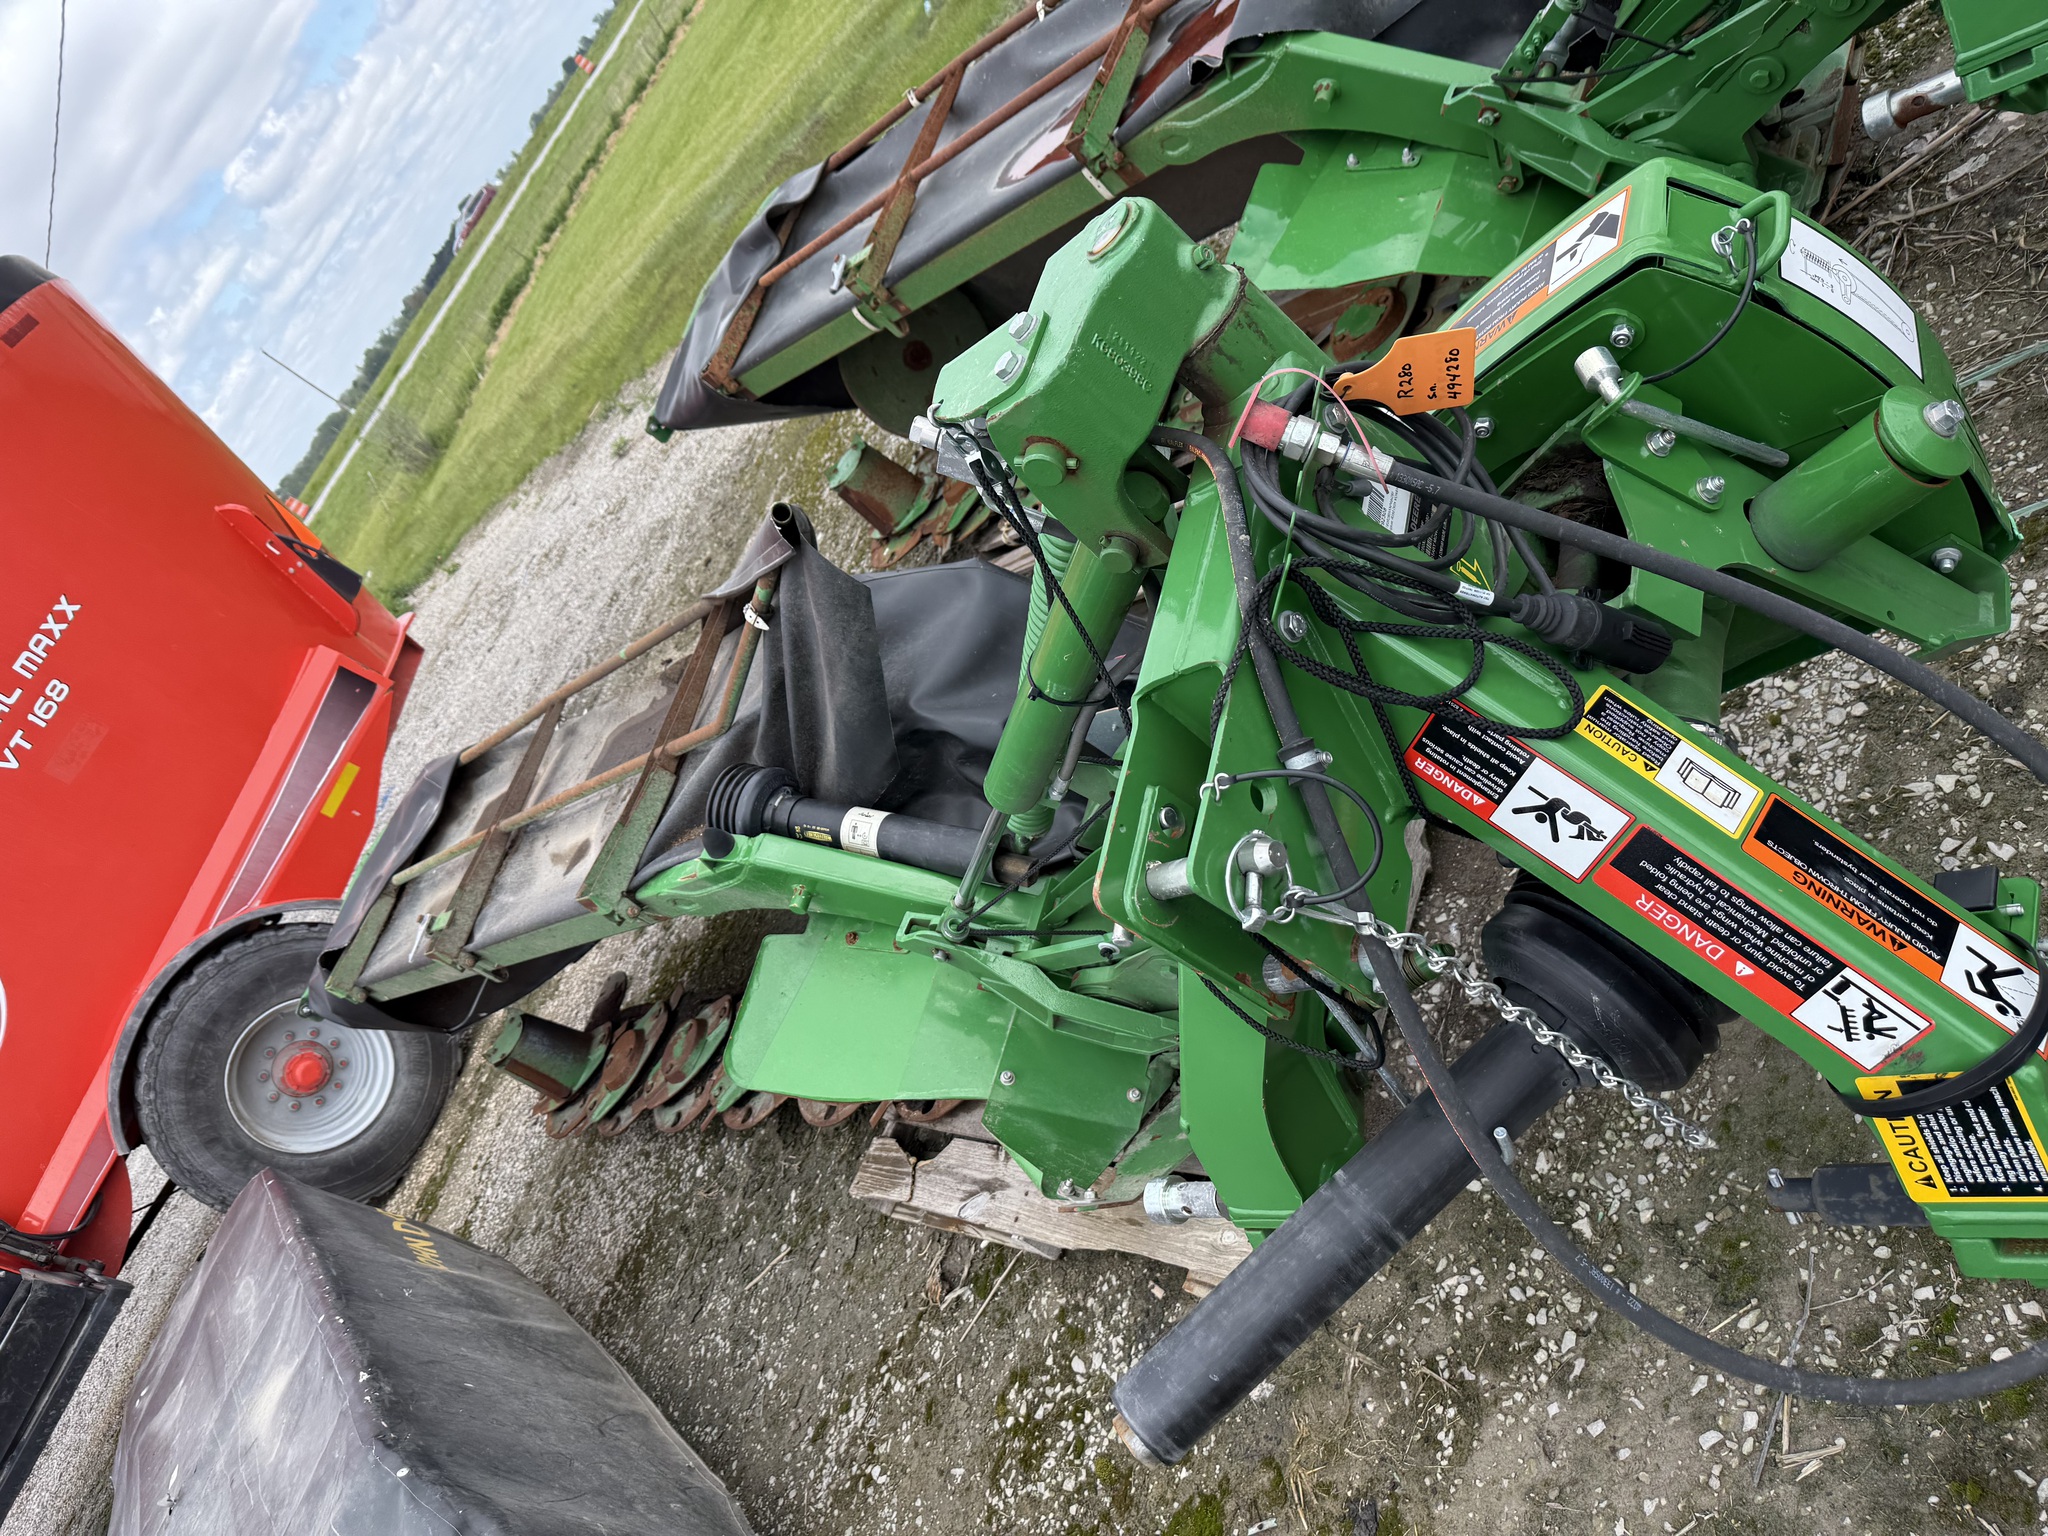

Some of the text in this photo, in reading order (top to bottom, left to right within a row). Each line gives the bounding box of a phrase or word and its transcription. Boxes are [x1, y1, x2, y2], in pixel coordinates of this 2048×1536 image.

[1397, 363, 1414, 399] R280
[1445, 348, 1462, 399] 494280
[12, 594, 82, 679] MAXX
[0, 728, 33, 769] VT
[27, 678, 70, 728] 168
[1441, 724, 1461, 739] place.
[1604, 696, 1675, 745] and safety rules when
[1605, 702, 1672, 750] Observe instructions
[1634, 728, 1647, 738] not
[1467, 741, 1490, 759] shields
[1481, 734, 1506, 752] contact
[1504, 739, 1530, 759] rotating
[1584, 723, 1637, 762] CAUTION
[1600, 717, 1664, 762] before handling the
[1612, 732, 1642, 752] operator
[1652, 740, 1670, 753] copy
[1422, 737, 1504, 793] driveline can cause serious
[1425, 747, 1450, 766] rotating
[1462, 754, 1481, 770] death.
[1489, 757, 1500, 765] all
[1505, 750, 1526, 765] Avoid
[1641, 751, 1661, 766] Read
[1414, 757, 1473, 800] DANGER
[1488, 773, 1508, 788] injury
[1499, 763, 1516, 777] Keep
[1456, 768, 1499, 800] Entanglement
[1814, 841, 1938, 927] do not operate near bystanders.
[1673, 855, 1833, 969] failure can allow wings to fall rapidly.
[1766, 839, 1941, 960] AVOID INJURY FROM THROWN OBJECTS
[1792, 870, 1886, 942] WARNING
[1843, 876, 1933, 940] Keep curtains in place.
[1635, 893, 1725, 960] DANGER
[1639, 860, 1815, 982] of machine when wings are being folded
[1664, 863, 1824, 975] or unfolded. Mechanical or hydraulic
[1654, 883, 1805, 991] To avoid injury or death stand clear
[1919, 1120, 1928, 1128] in
[1936, 1112, 1952, 1134] motor
[1949, 1116, 1958, 1125] or
[1965, 1108, 1979, 1122] and
[1999, 1107, 2018, 1136] running
[1873, 1090, 1928, 1173] CAUTIN
[1922, 1128, 1940, 1154] shields
[1953, 1126, 1974, 1159] servicing
[1972, 1123, 1986, 1138] feet
[1925, 1114, 1969, 1193] 2. Disengage and shut
[1977, 1106, 2017, 1182] ing away from power-
[1981, 1138, 1997, 1163] hands,
[2013, 1137, 2028, 1157] leave
[1933, 1154, 1945, 1164] all
[1958, 1158, 1974, 1183] engine
[1968, 1133, 1998, 1183] ging machine.
[1969, 1159, 1985, 1182] before
[2003, 1137, 2028, 1182] driven parts.
[2021, 1157, 2034, 1170] not
[1940, 1164, 1954, 1183] Keep
[1992, 1163, 2006, 1182] Keep
[2029, 1170, 2039, 1182] Do
[2034, 1184, 2043, 1192] 4.
